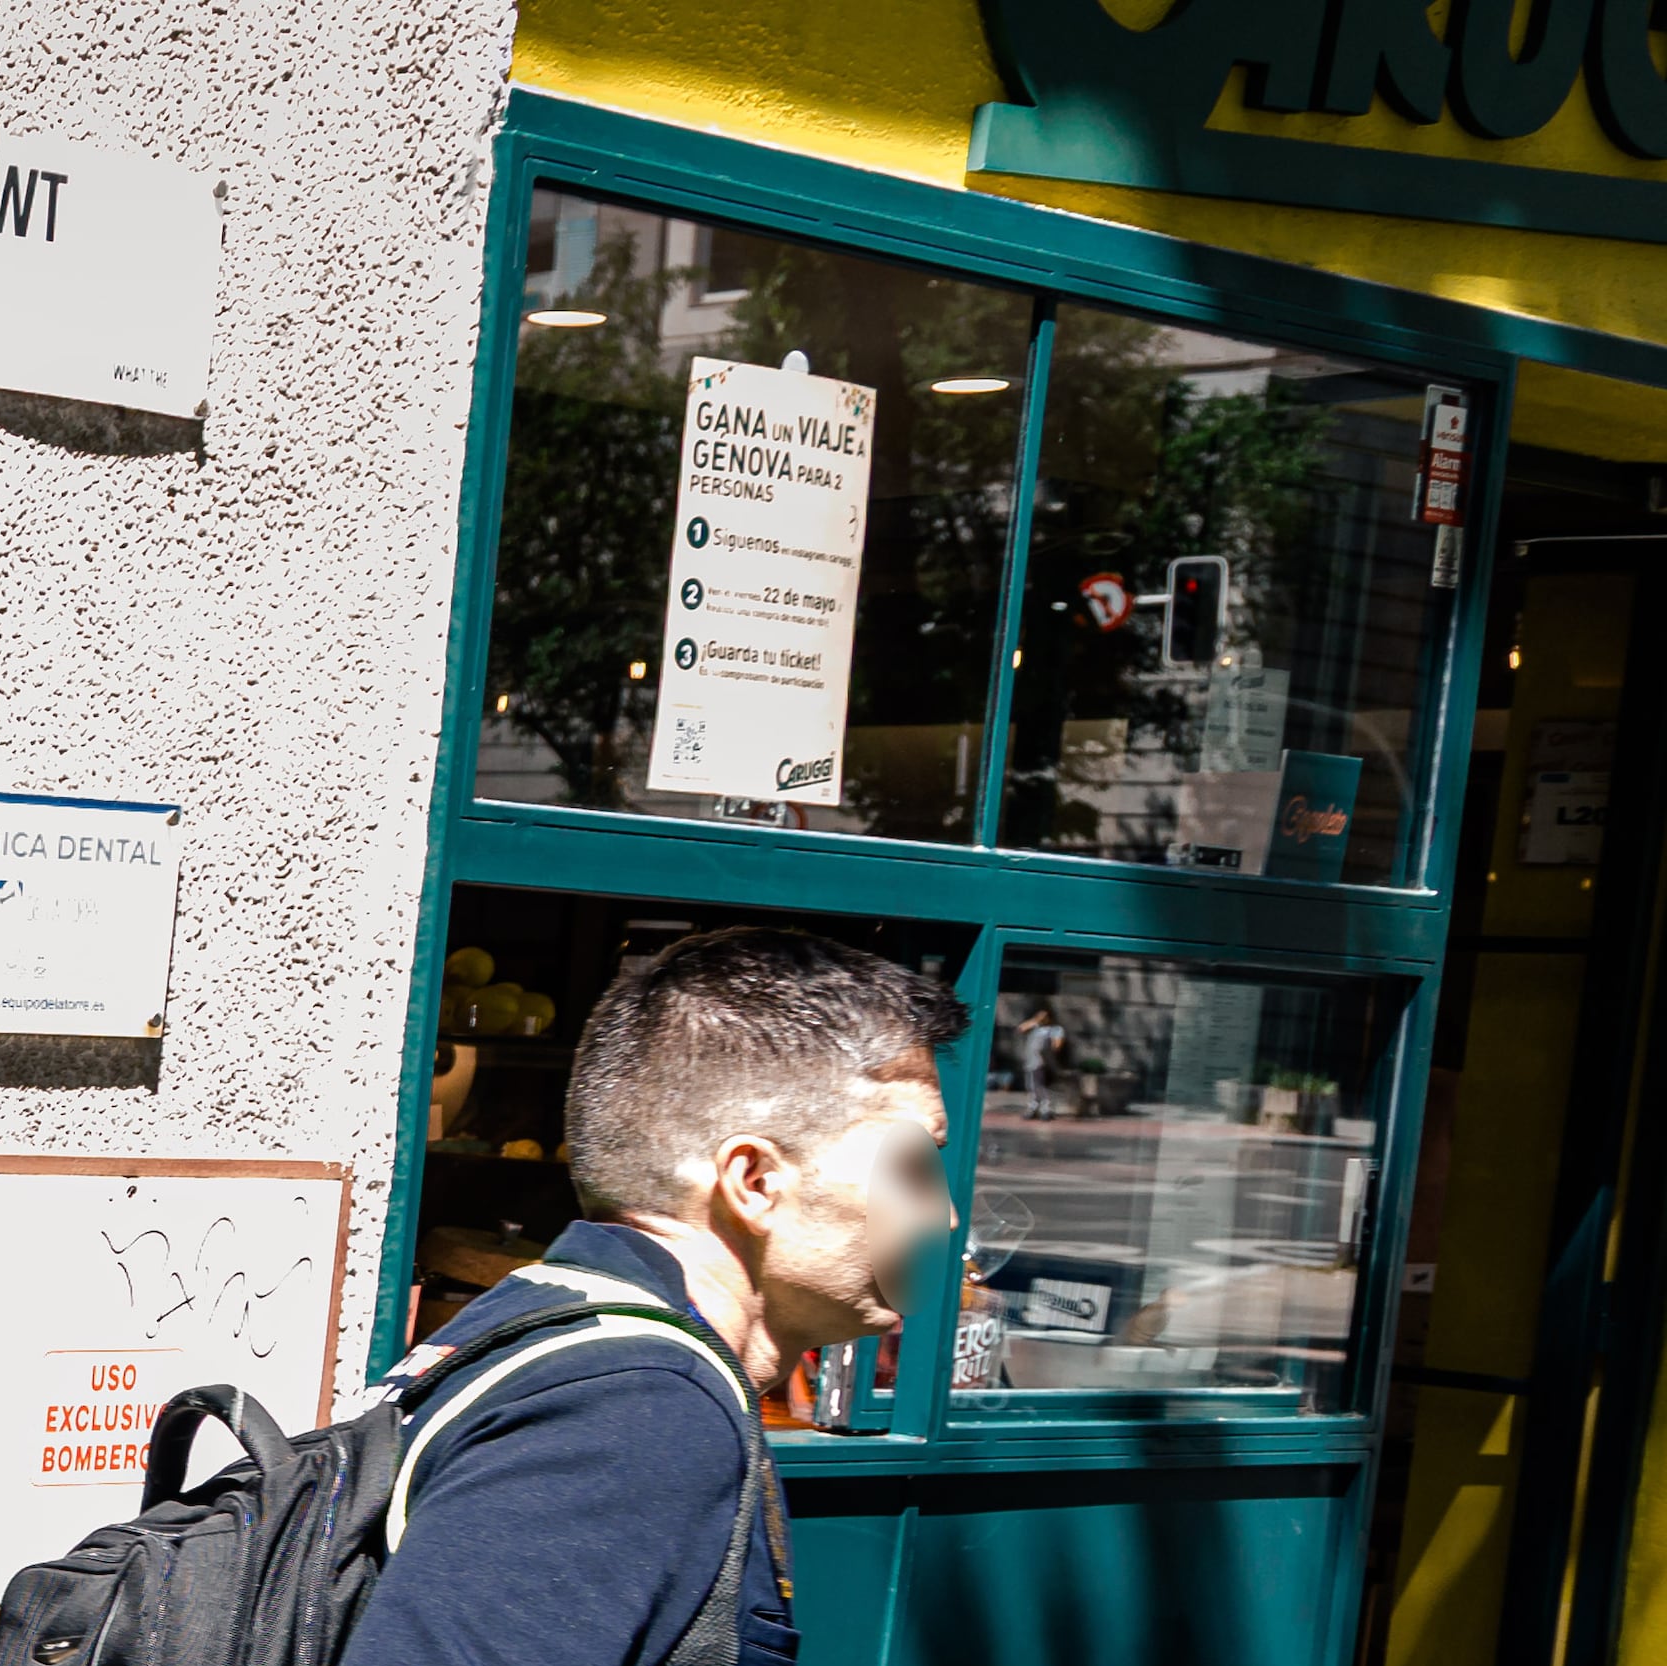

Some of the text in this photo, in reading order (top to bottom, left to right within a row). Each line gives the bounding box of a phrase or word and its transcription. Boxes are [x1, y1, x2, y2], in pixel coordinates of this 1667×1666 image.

[696, 400, 768, 440] GANA
[771, 423, 794, 443] UN
[798, 415, 857, 456] VIAJE
[692, 432, 844, 491] GÉNOVA PARA 2
[689, 474, 775, 503] PERSONAS
[713, 527, 780, 554] Síguenos
[763, 586, 780, 604] 22
[784, 587, 799, 607] de
[801, 593, 836, 616] mayo
[700, 639, 760, 664] ¡Guarda
[763, 648, 777, 666] tu
[57, 835, 163, 866] DENTAL
[91, 1364, 137, 1392] USO
[45, 1403, 164, 1433] EXCLUSIV
[41, 1442, 152, 1473] BOMBERO
